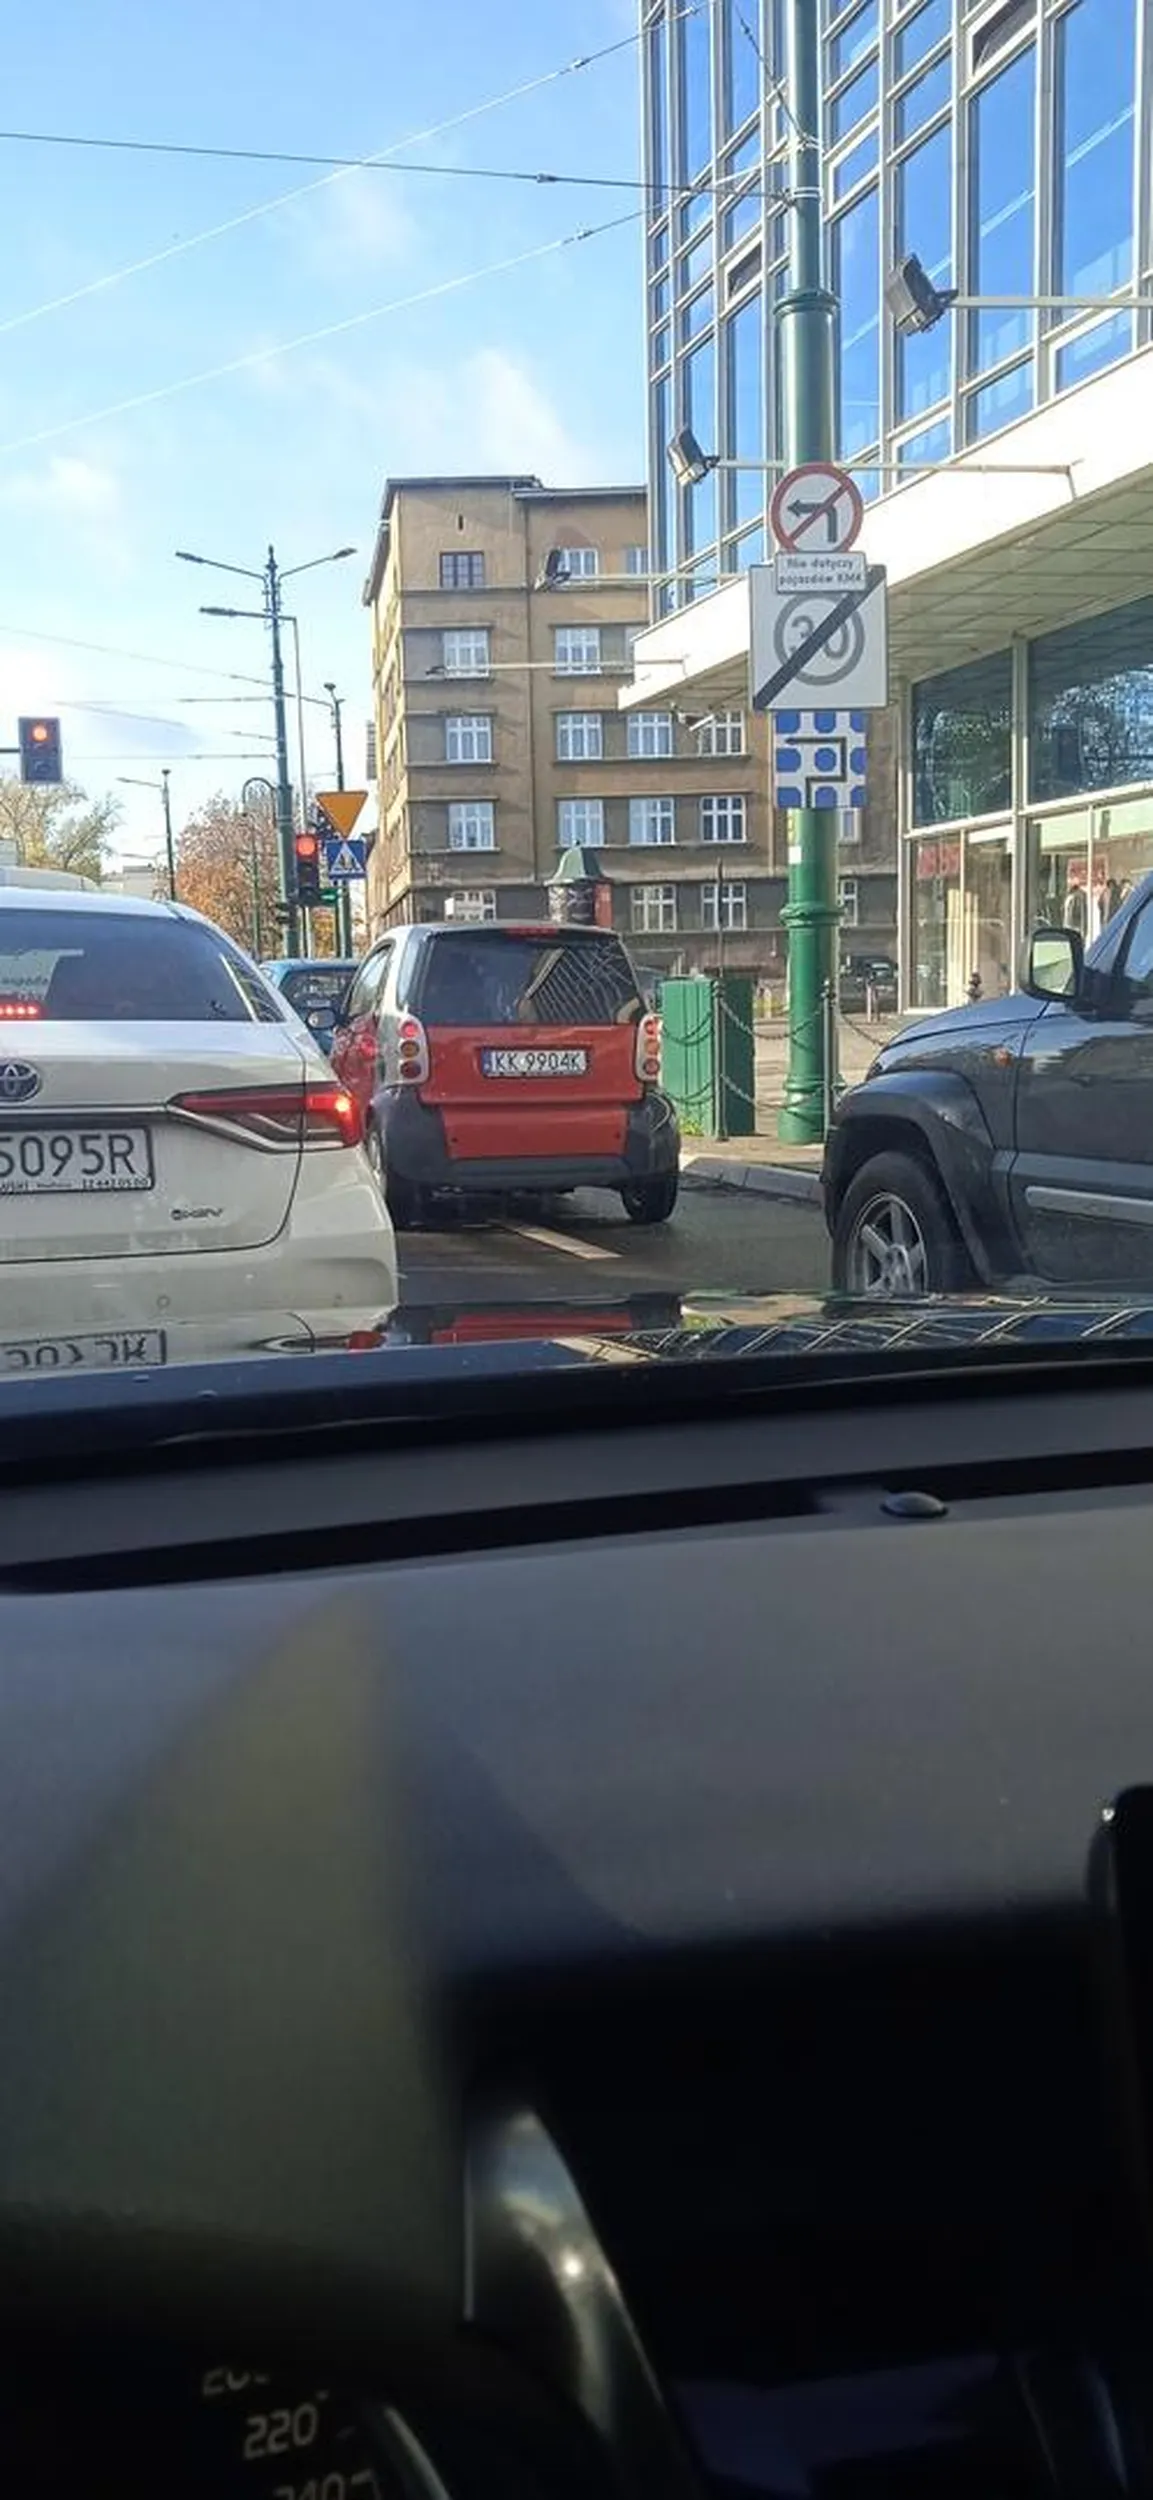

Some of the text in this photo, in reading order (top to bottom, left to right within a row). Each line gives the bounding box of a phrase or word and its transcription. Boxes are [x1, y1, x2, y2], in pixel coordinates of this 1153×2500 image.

[779, 573, 834, 586] pojazdów
[786, 558, 854, 571] Nie dotyczy
[790, 615, 849, 660] 30
[495, 1052, 581, 1071] KK 9904K
[0, 1133, 136, 1177] 5095R
[243, 2402, 319, 2461] 220
